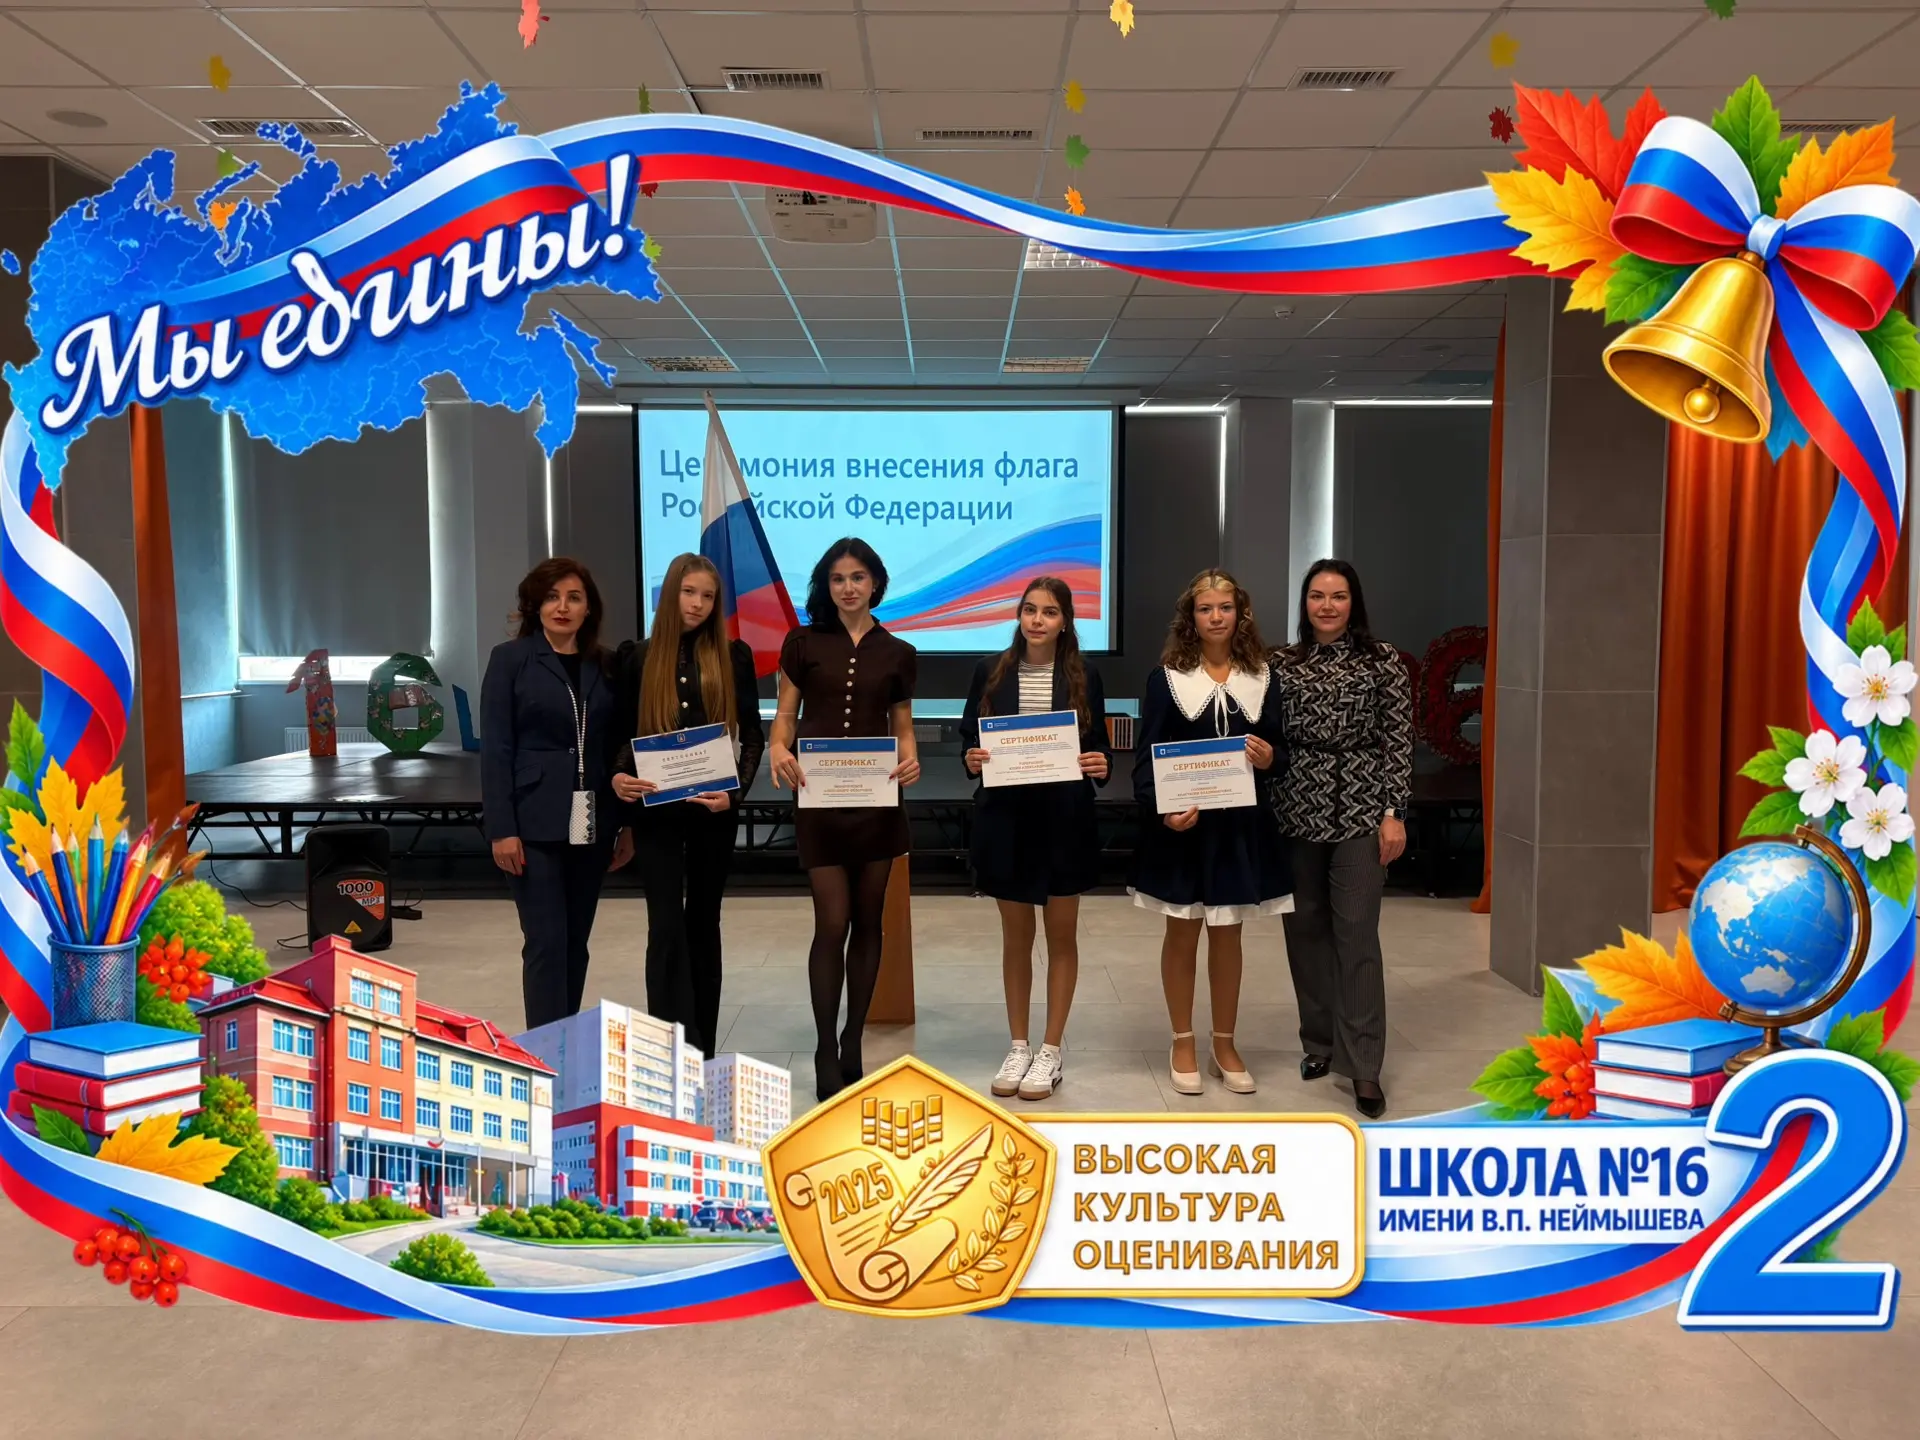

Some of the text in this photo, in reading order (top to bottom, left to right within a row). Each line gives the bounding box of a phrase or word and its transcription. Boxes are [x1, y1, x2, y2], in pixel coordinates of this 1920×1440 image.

[660, 449, 1079, 486] Цемония внесения флага
[845, 490, 1013, 527] Федерации
[1000, 733, 1059, 745] СЕРТИФИКАТ
[818, 758, 877, 767] СЕРТИФИКАТ
[1172, 759, 1231, 772] СЕРТИФИКАТ
[337, 881, 374, 895] 1000
